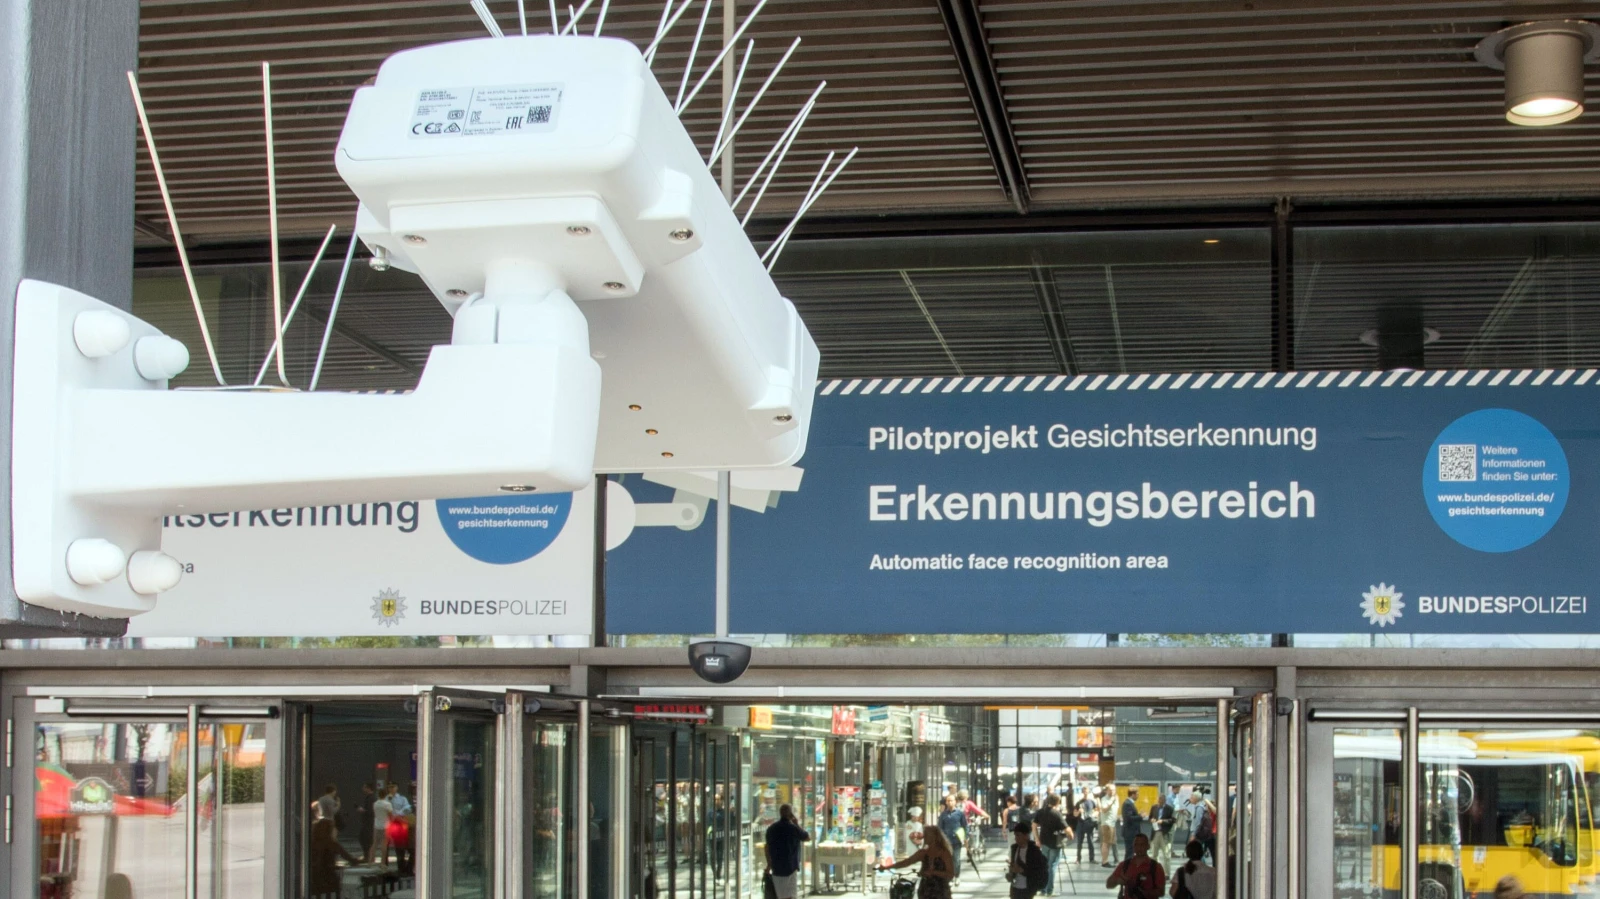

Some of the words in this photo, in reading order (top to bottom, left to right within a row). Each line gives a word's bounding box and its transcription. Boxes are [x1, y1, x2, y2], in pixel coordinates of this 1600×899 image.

[869, 426, 1039, 455] Pilotprojekt
[1047, 422, 1318, 451] Gesichtserkennung
[1482, 445, 1518, 455] Weitere
[1482, 458, 1546, 468] Informationen
[1482, 471, 1512, 481] finden
[1513, 471, 1529, 481] Sie
[1531, 472, 1558, 481] unter:
[869, 481, 1316, 527] Erkennungsbereich
[1438, 492, 1555, 504] www.bundespolizei.de/
[448, 504, 559, 516] www.bundespolizei.de/
[1448, 506, 1545, 517] gesichtserkennung
[457, 518, 549, 530] gesichtserkennung
[869, 553, 964, 571] Automatic
[967, 553, 1009, 570] face
[1013, 552, 1121, 573] recognition
[1126, 556, 1169, 569] area
[420, 600, 567, 616] BUNDESPOLIZEI
[1418, 596, 1587, 614] BUNDESPOLIZEI
